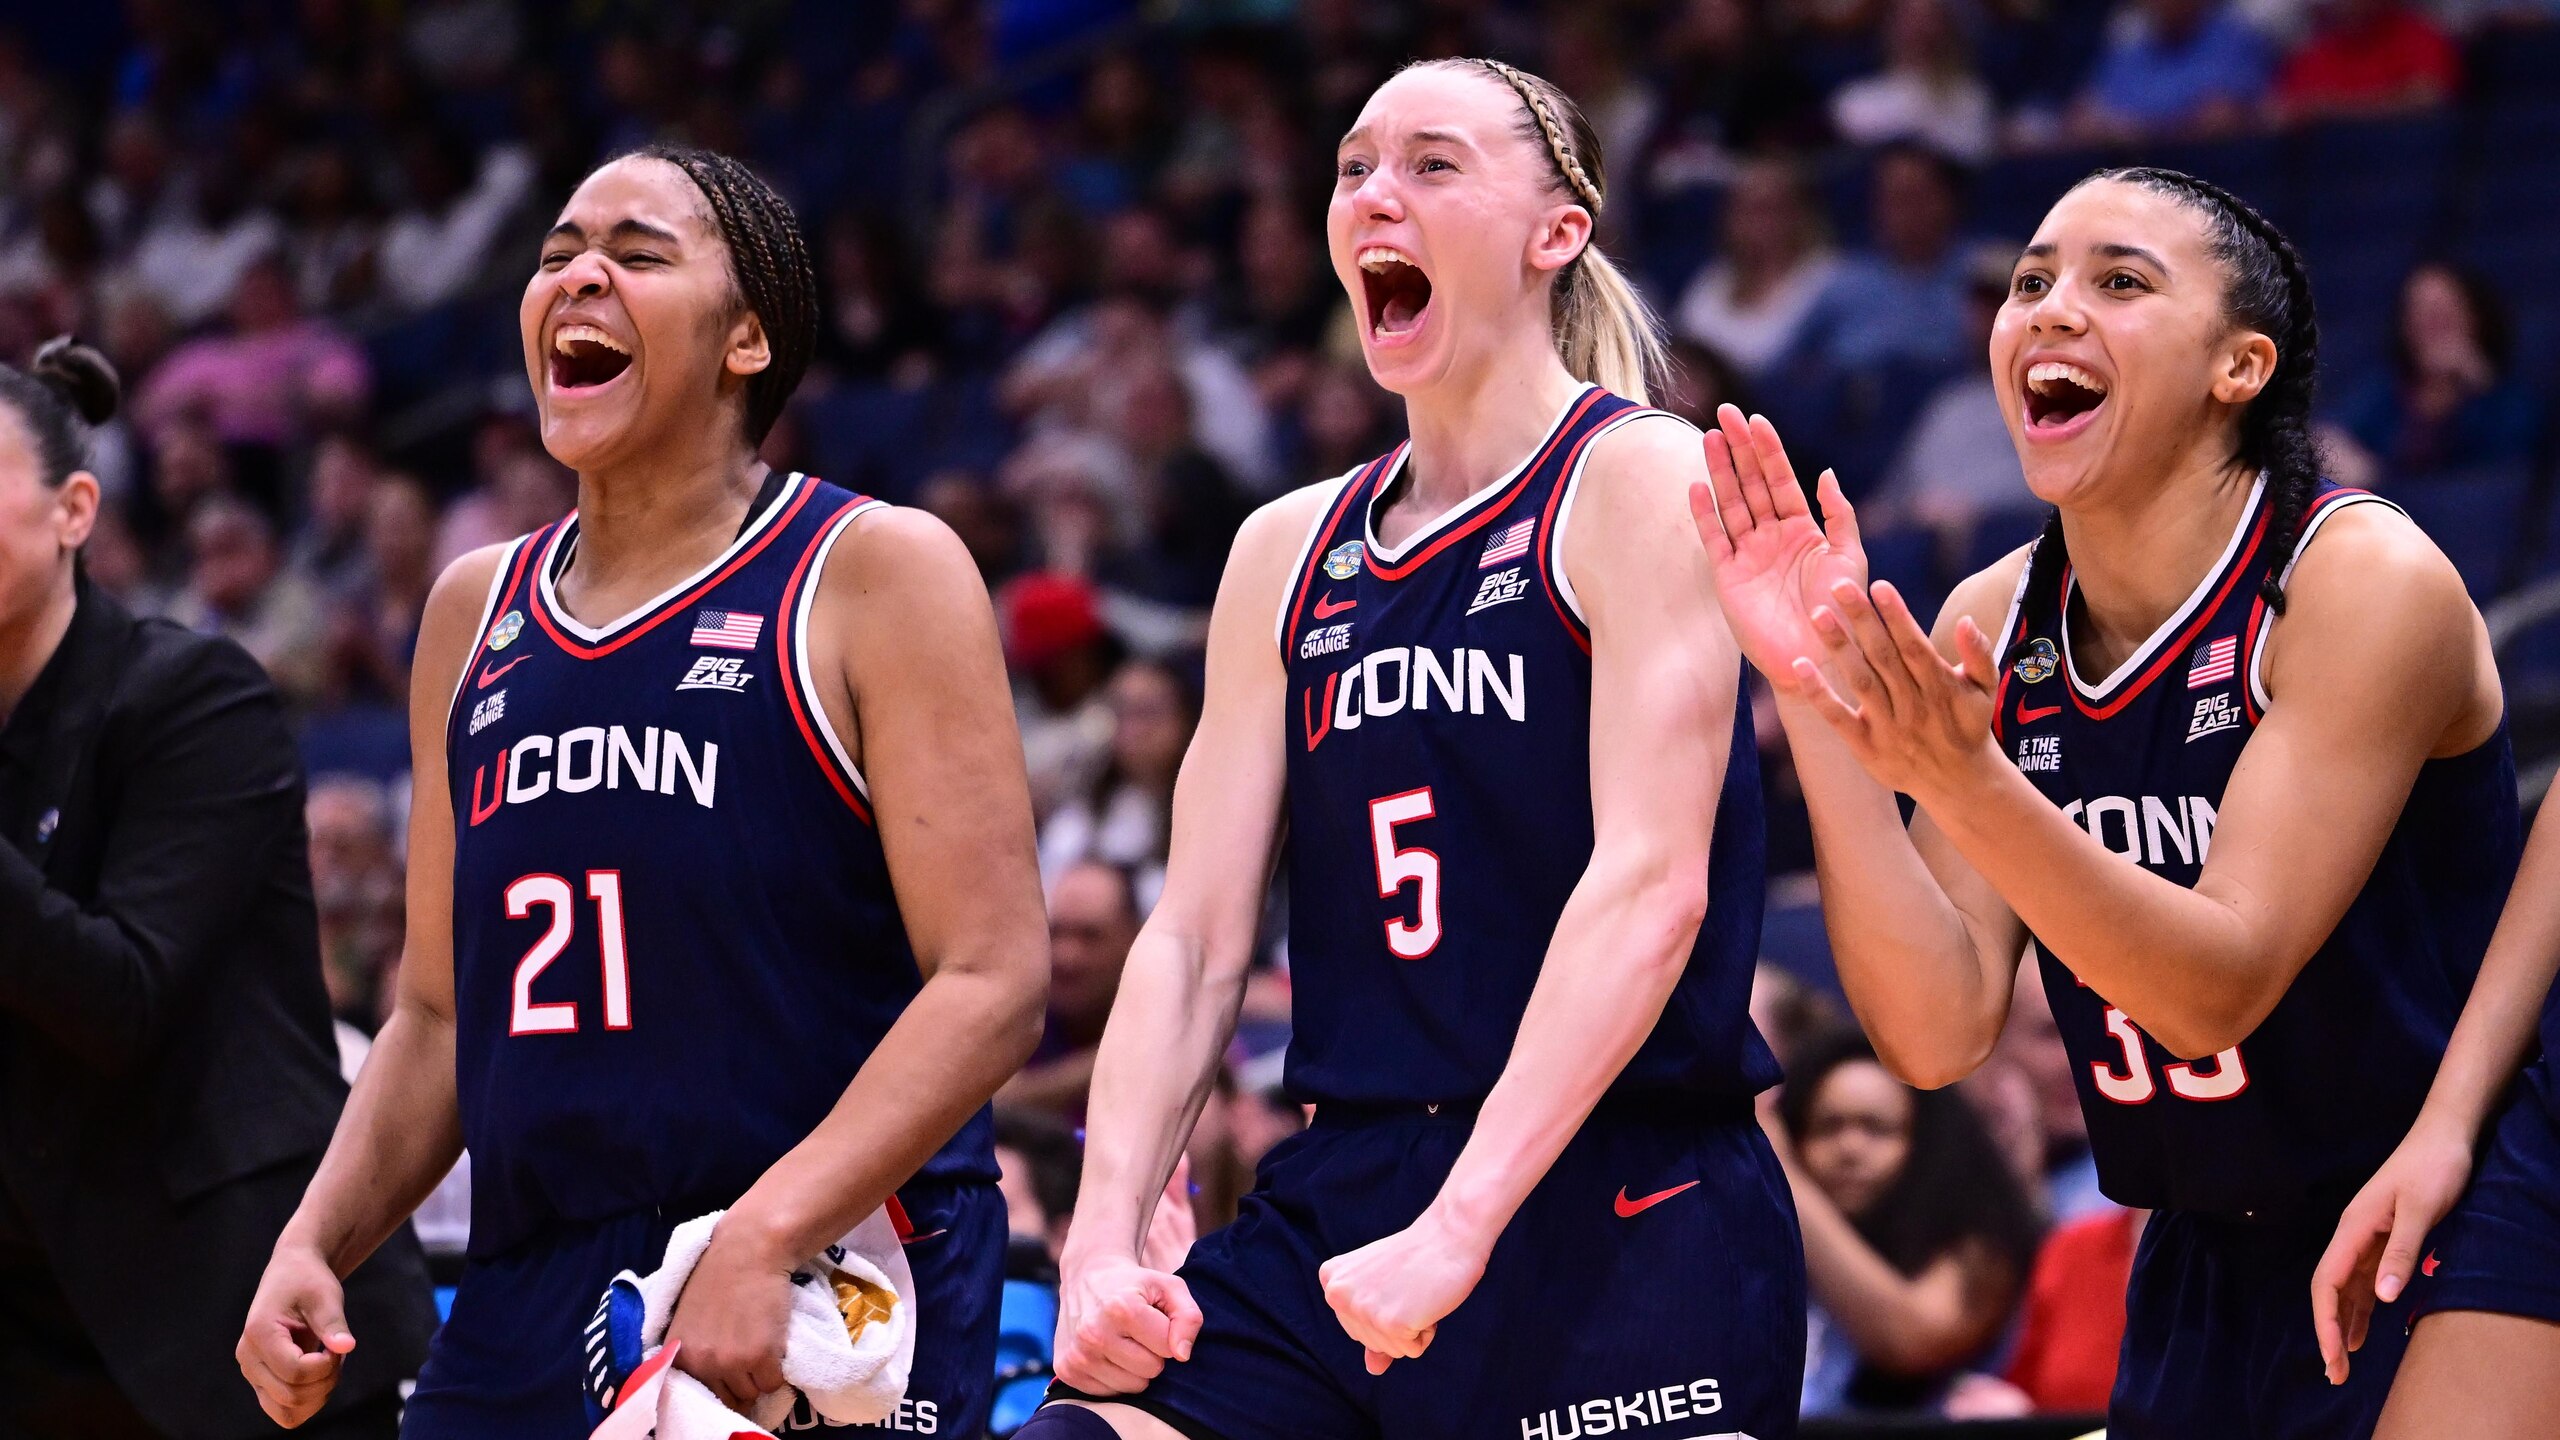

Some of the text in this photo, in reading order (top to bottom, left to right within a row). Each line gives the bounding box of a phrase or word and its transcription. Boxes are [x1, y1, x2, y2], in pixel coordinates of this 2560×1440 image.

[1470, 578, 1530, 607] EAST
[1478, 566, 1521, 592] BIG
[1300, 632, 1351, 660] CHANGE
[1304, 622, 1355, 643] BE THE
[681, 669, 755, 687] EAST
[692, 655, 745, 673] BIG
[472, 688, 508, 720] BE THE
[1304, 645, 1526, 752] UCONN
[2193, 692, 2230, 717] BIG
[469, 702, 506, 736] CHANGE
[2188, 706, 2241, 734] EAST
[2031, 736, 2061, 754] THE
[469, 724, 719, 827] UCONN
[2018, 753, 2062, 772] HANGE
[1368, 785, 1443, 960] 5
[503, 869, 633, 1037] 21
[1520, 1378, 1723, 1440] HUSKIES
